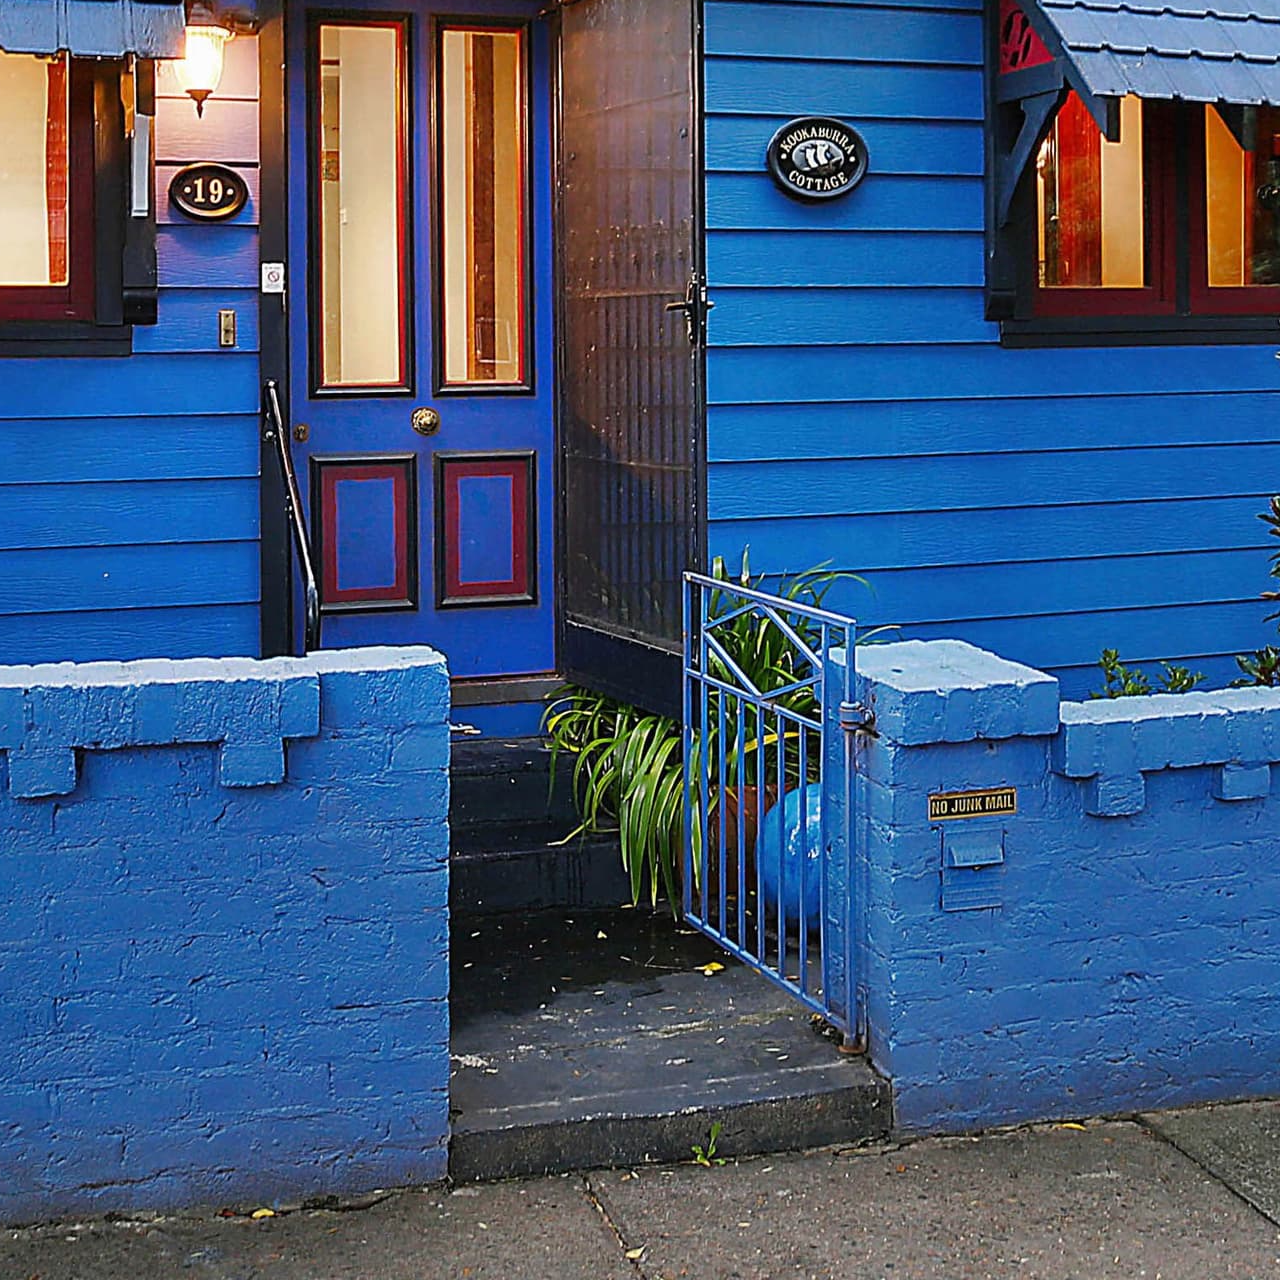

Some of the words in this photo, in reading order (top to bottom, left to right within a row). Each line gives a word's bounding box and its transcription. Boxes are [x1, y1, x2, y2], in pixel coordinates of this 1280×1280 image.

[779, 126, 856, 155] KOOKABURRA
[193, 177, 223, 204] 19
[788, 170, 848, 191] COTTAGE
[931, 800, 948, 815] NO
[951, 797, 983, 813] JUNK
[985, 795, 1013, 810] MAIL
